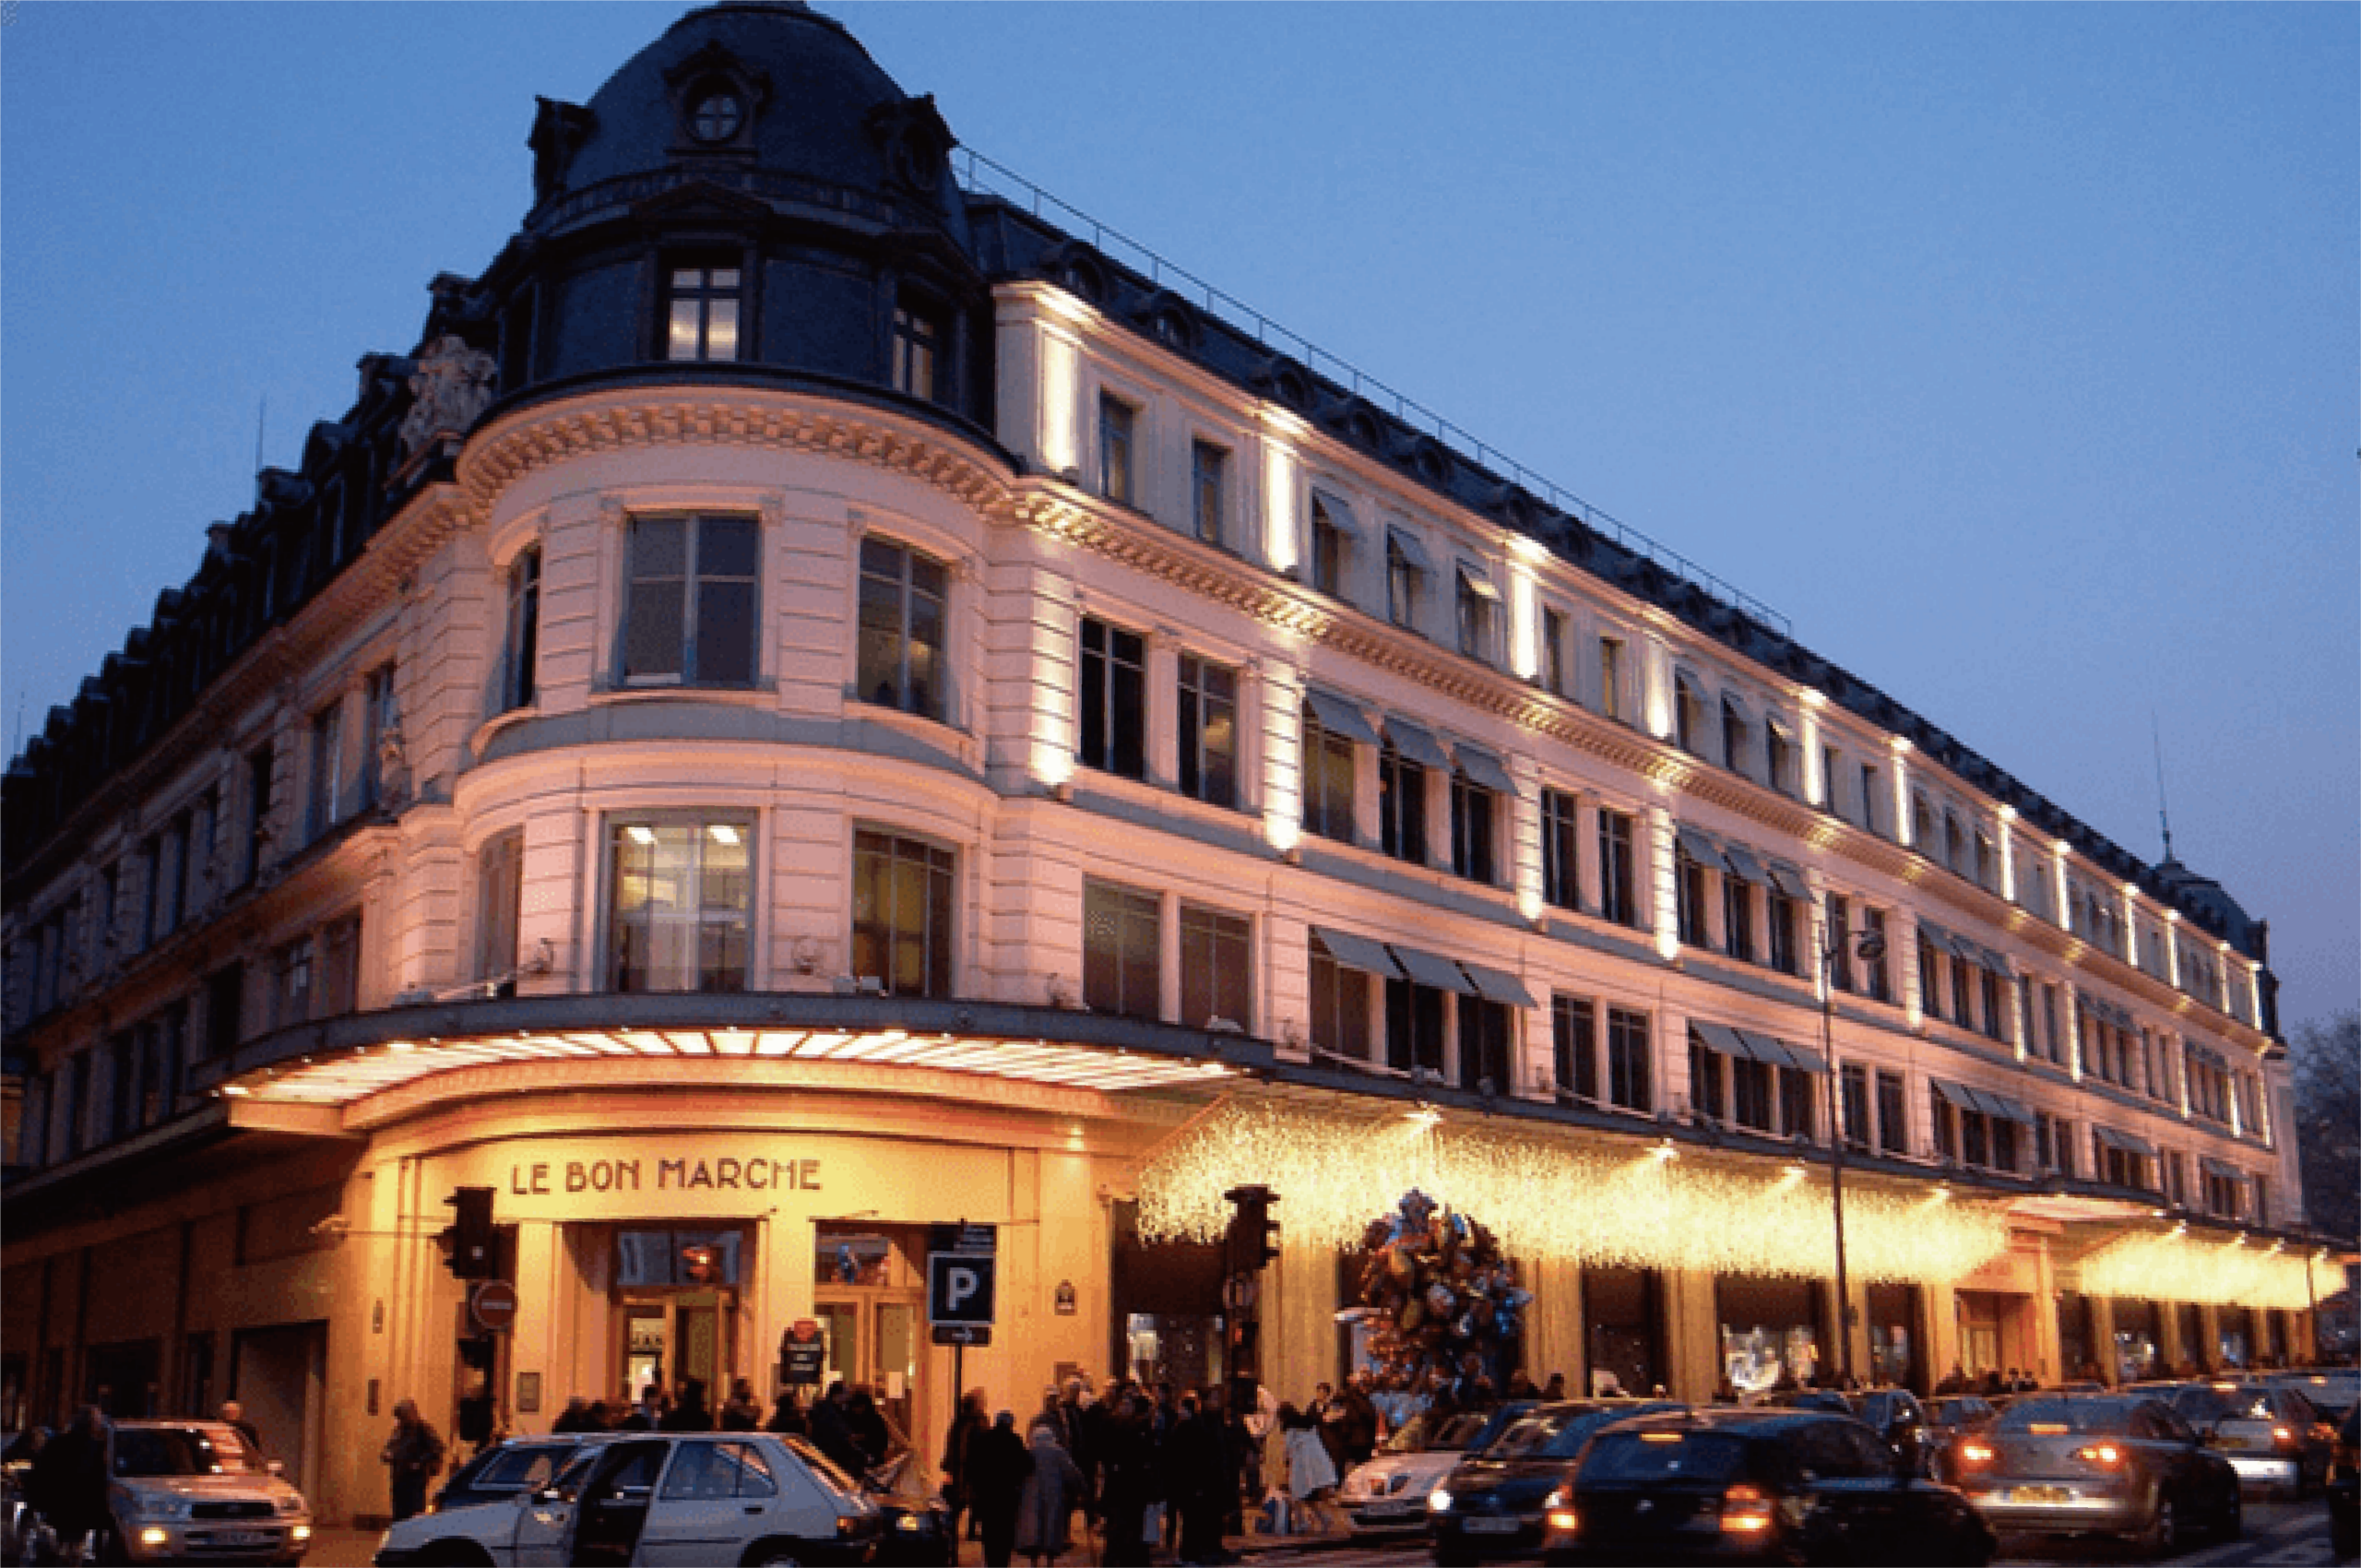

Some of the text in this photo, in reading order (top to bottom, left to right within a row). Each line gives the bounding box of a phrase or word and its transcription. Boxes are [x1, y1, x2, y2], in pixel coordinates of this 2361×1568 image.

[510, 1157, 823, 1194] LE BON MARCHE
[948, 1266, 979, 1311] P
